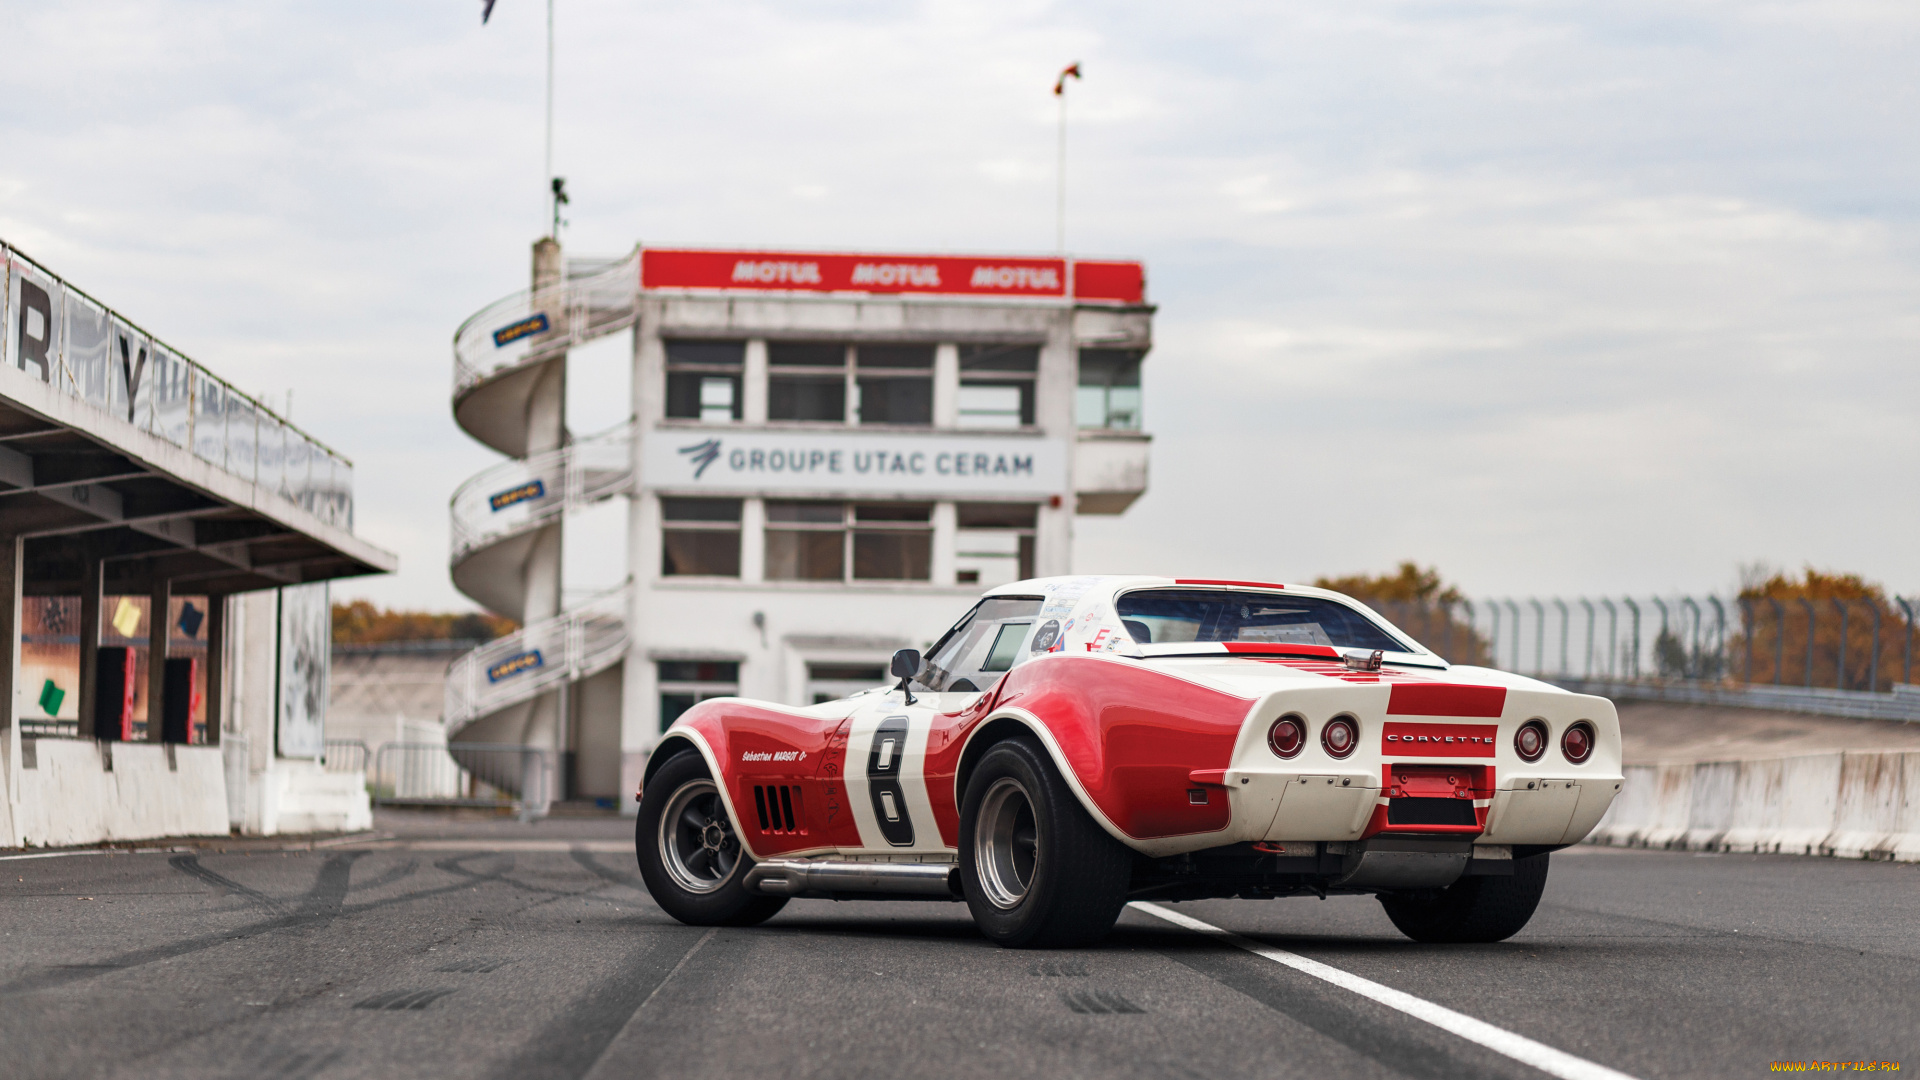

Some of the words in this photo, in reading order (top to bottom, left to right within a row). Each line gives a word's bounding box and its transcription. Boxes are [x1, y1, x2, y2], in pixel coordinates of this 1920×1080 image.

[731, 260, 822, 284] MOTUL
[851, 263, 943, 287] MOTUL
[970, 265, 1060, 289] MOTUL
[729, 448, 844, 474] GROUPE
[854, 450, 927, 475] UTAC
[935, 452, 1034, 477] CERAM
[1387, 735, 1493, 743] CORVETTE
[773, 751, 799, 761] MARGOT
[866, 715, 915, 847] 8
